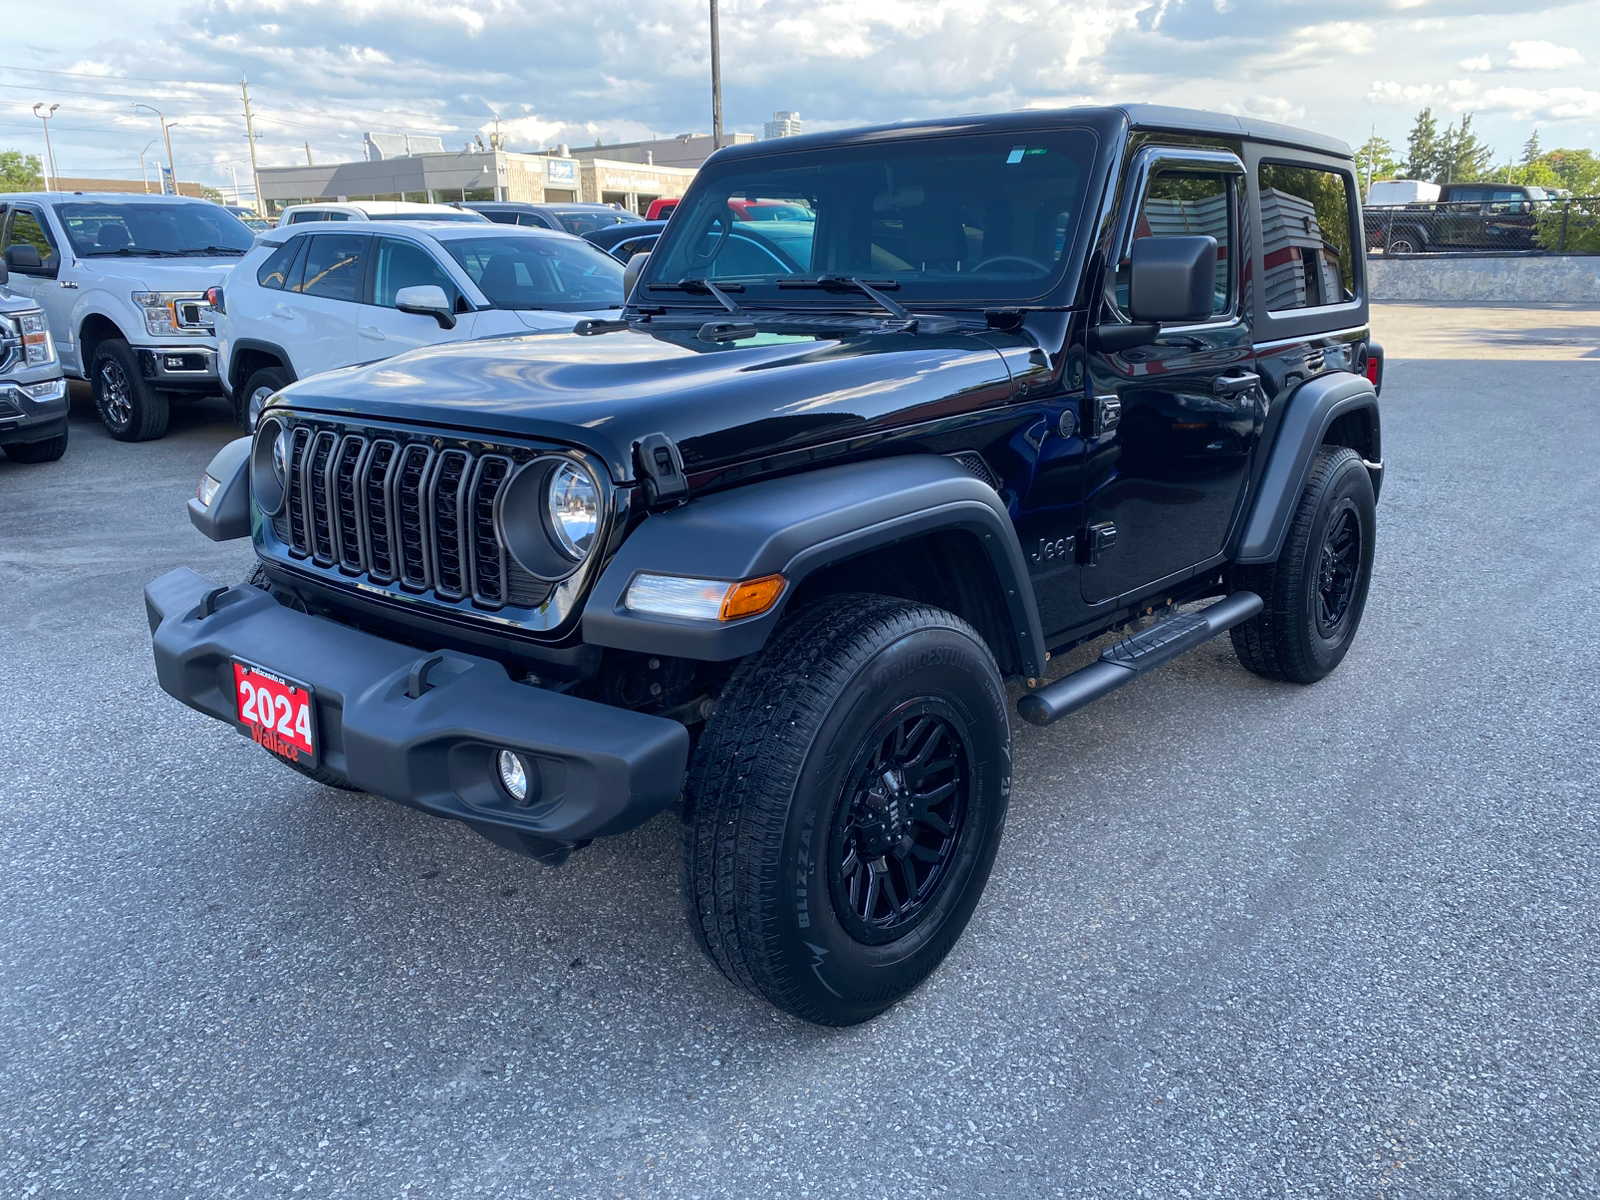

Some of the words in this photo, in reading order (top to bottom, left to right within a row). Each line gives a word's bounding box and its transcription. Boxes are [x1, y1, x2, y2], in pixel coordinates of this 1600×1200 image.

[1031, 536, 1075, 564] Jeep
[1030, 563, 1074, 582] WRANGLER
[871, 645, 974, 692] BRIDGESTONE
[240, 680, 311, 745] 2024
[250, 721, 299, 762] Wallace
[796, 803, 817, 929] BLIZZAK
